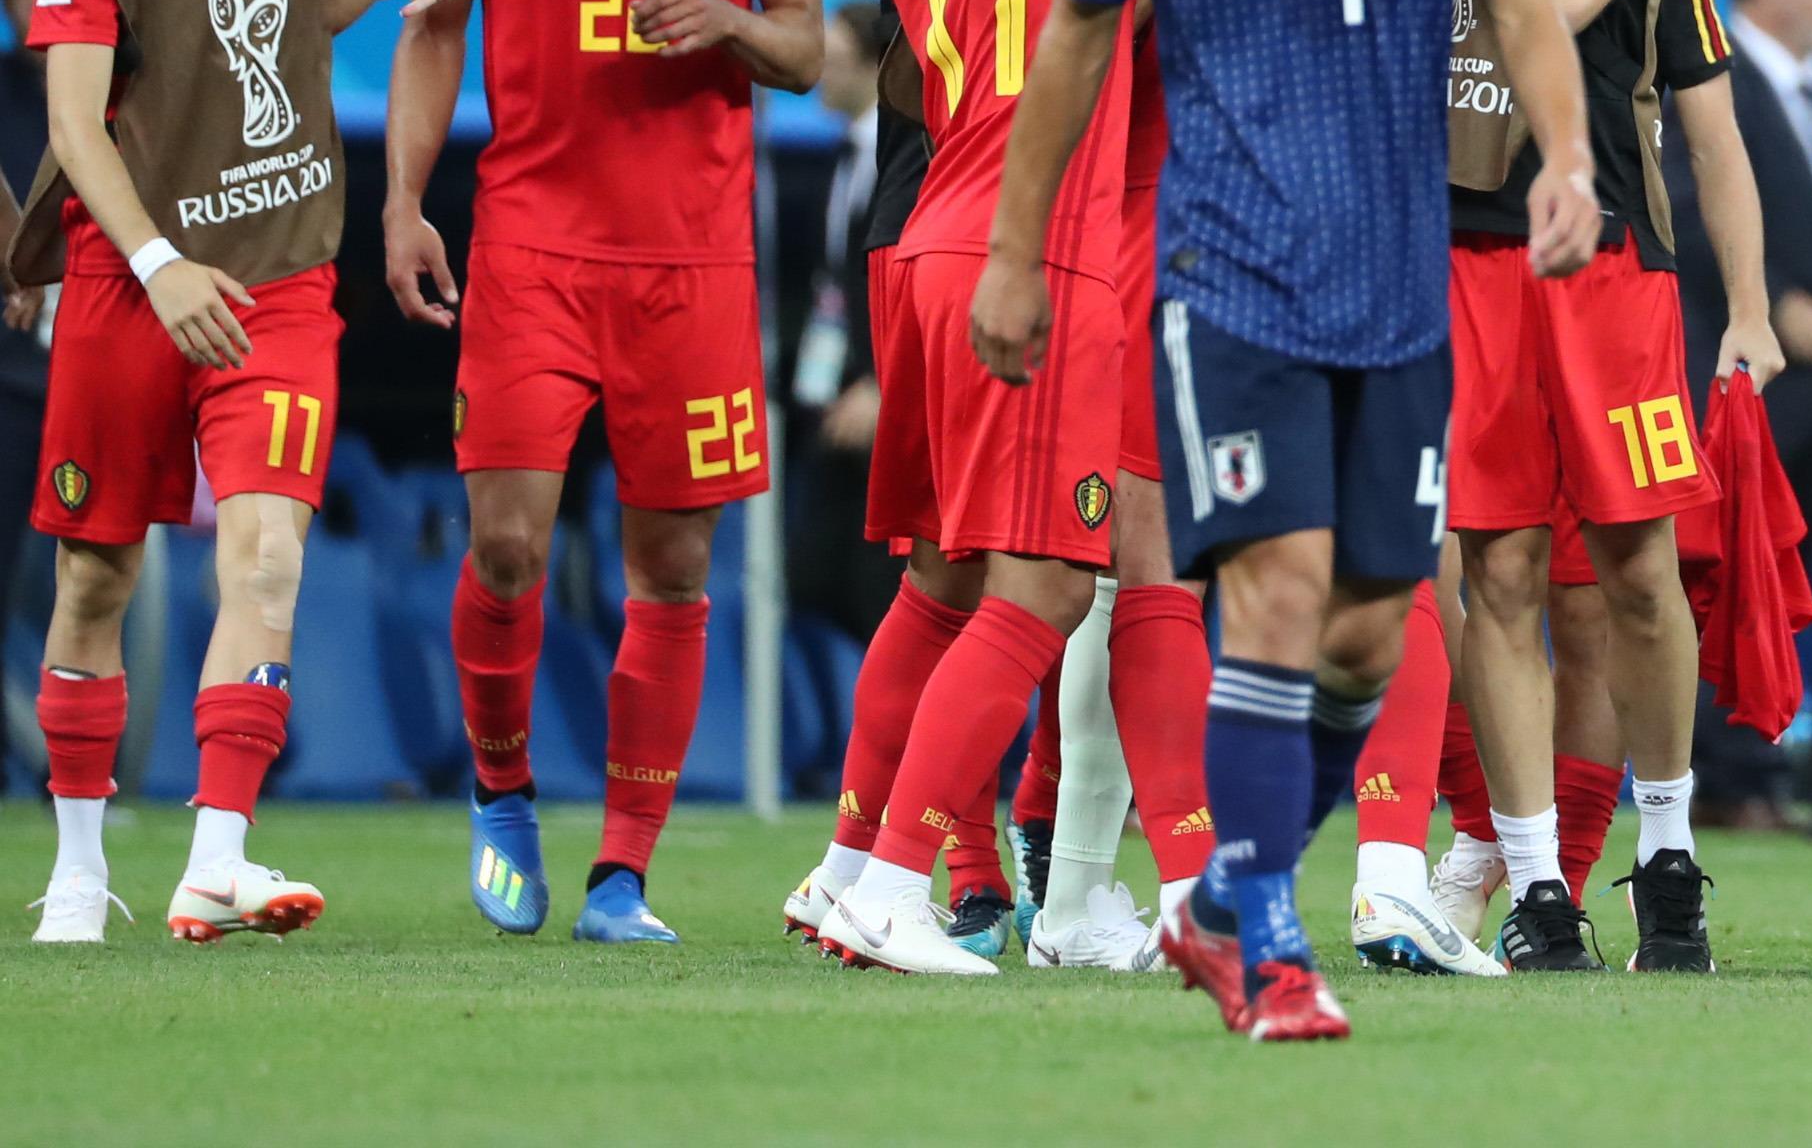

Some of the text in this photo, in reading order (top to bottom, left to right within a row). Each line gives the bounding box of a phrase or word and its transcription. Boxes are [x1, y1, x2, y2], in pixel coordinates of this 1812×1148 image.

[1464, 57, 1494, 75] CUP
[1454, 78, 1514, 115] 201
[220, 164, 249, 186] FIFA
[247, 151, 300, 178] WORLD
[177, 174, 299, 229] RUSSIA
[262, 389, 322, 477] 11
[685, 386, 761, 480] 22
[1606, 394, 1699, 489] 18
[1414, 445, 1448, 546] 4
[606, 761, 679, 784] BELGIUM
[1357, 789, 1401, 802] adidas
[1171, 822, 1215, 835] adida
